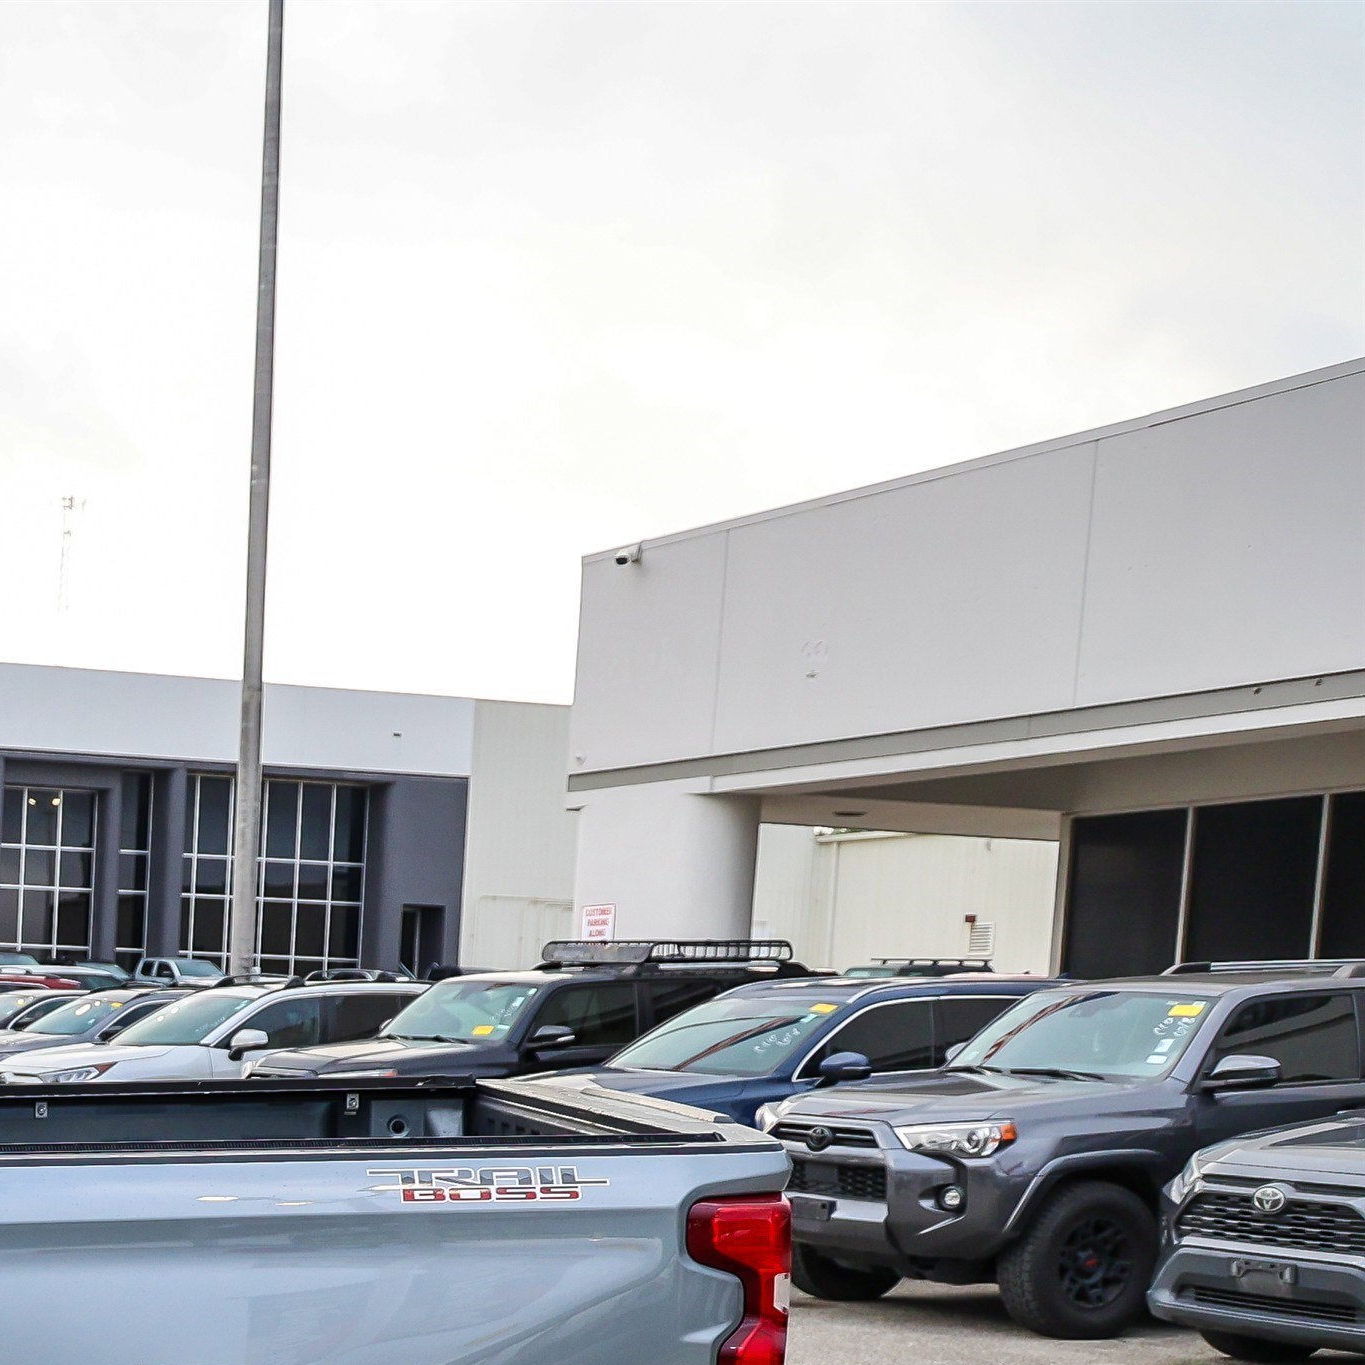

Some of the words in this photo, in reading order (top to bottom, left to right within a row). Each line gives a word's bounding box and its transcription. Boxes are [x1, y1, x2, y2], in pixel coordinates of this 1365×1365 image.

[585, 907, 612, 916] CUSTOMER
[587, 918, 609, 926] PARKING
[367, 1166, 610, 1187] TRAIL
[401, 1185, 582, 1203] BOSS
